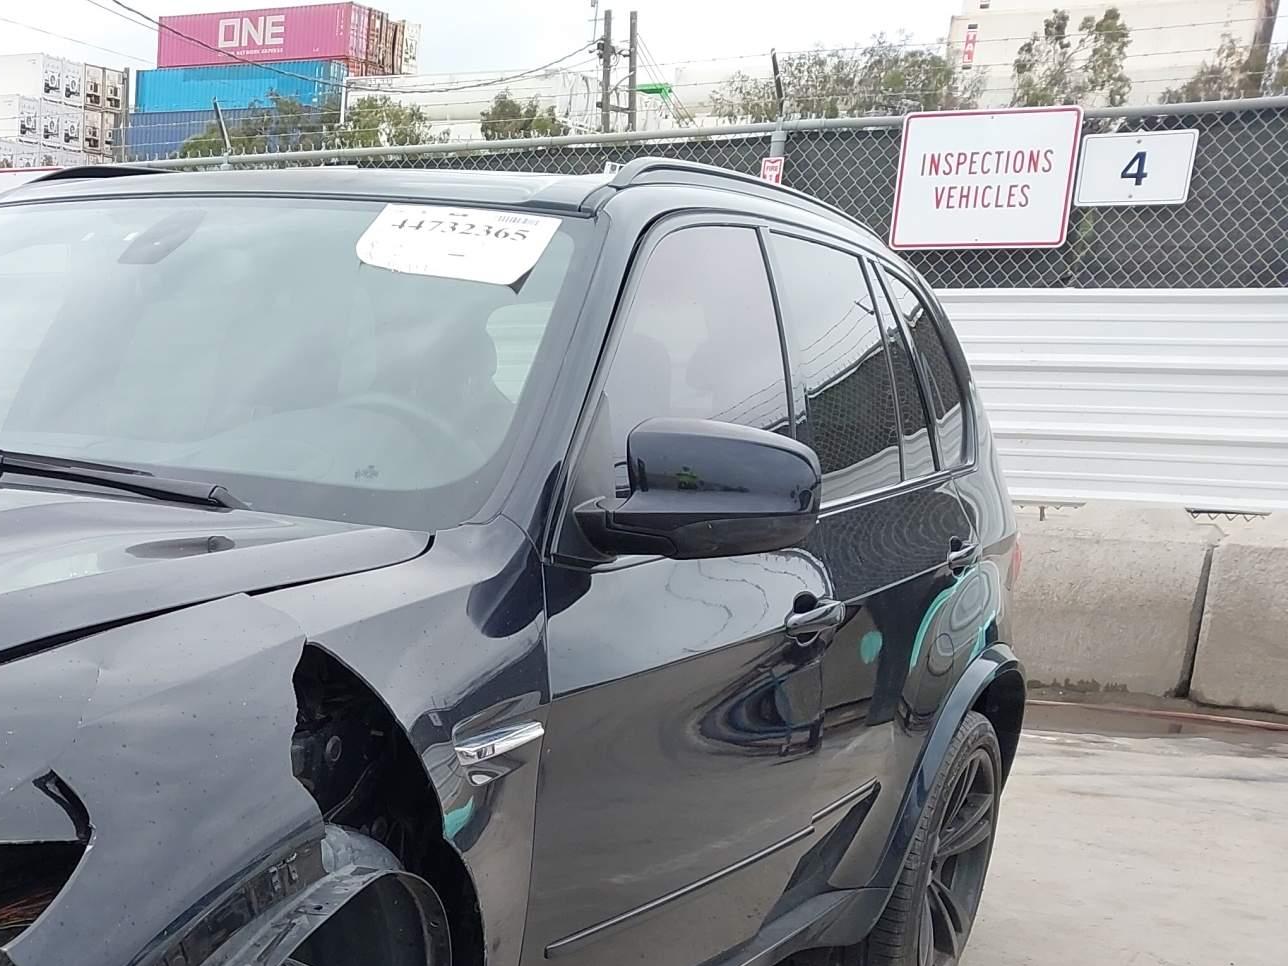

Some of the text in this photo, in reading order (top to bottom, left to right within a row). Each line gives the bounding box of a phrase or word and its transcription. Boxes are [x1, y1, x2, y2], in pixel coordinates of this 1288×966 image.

[218, 15, 285, 48] ONE
[920, 149, 1054, 177] INSPECTIONS
[1120, 151, 1148, 187] 4
[934, 184, 1031, 210] VEHICLES
[391, 217, 530, 241] 44732365
